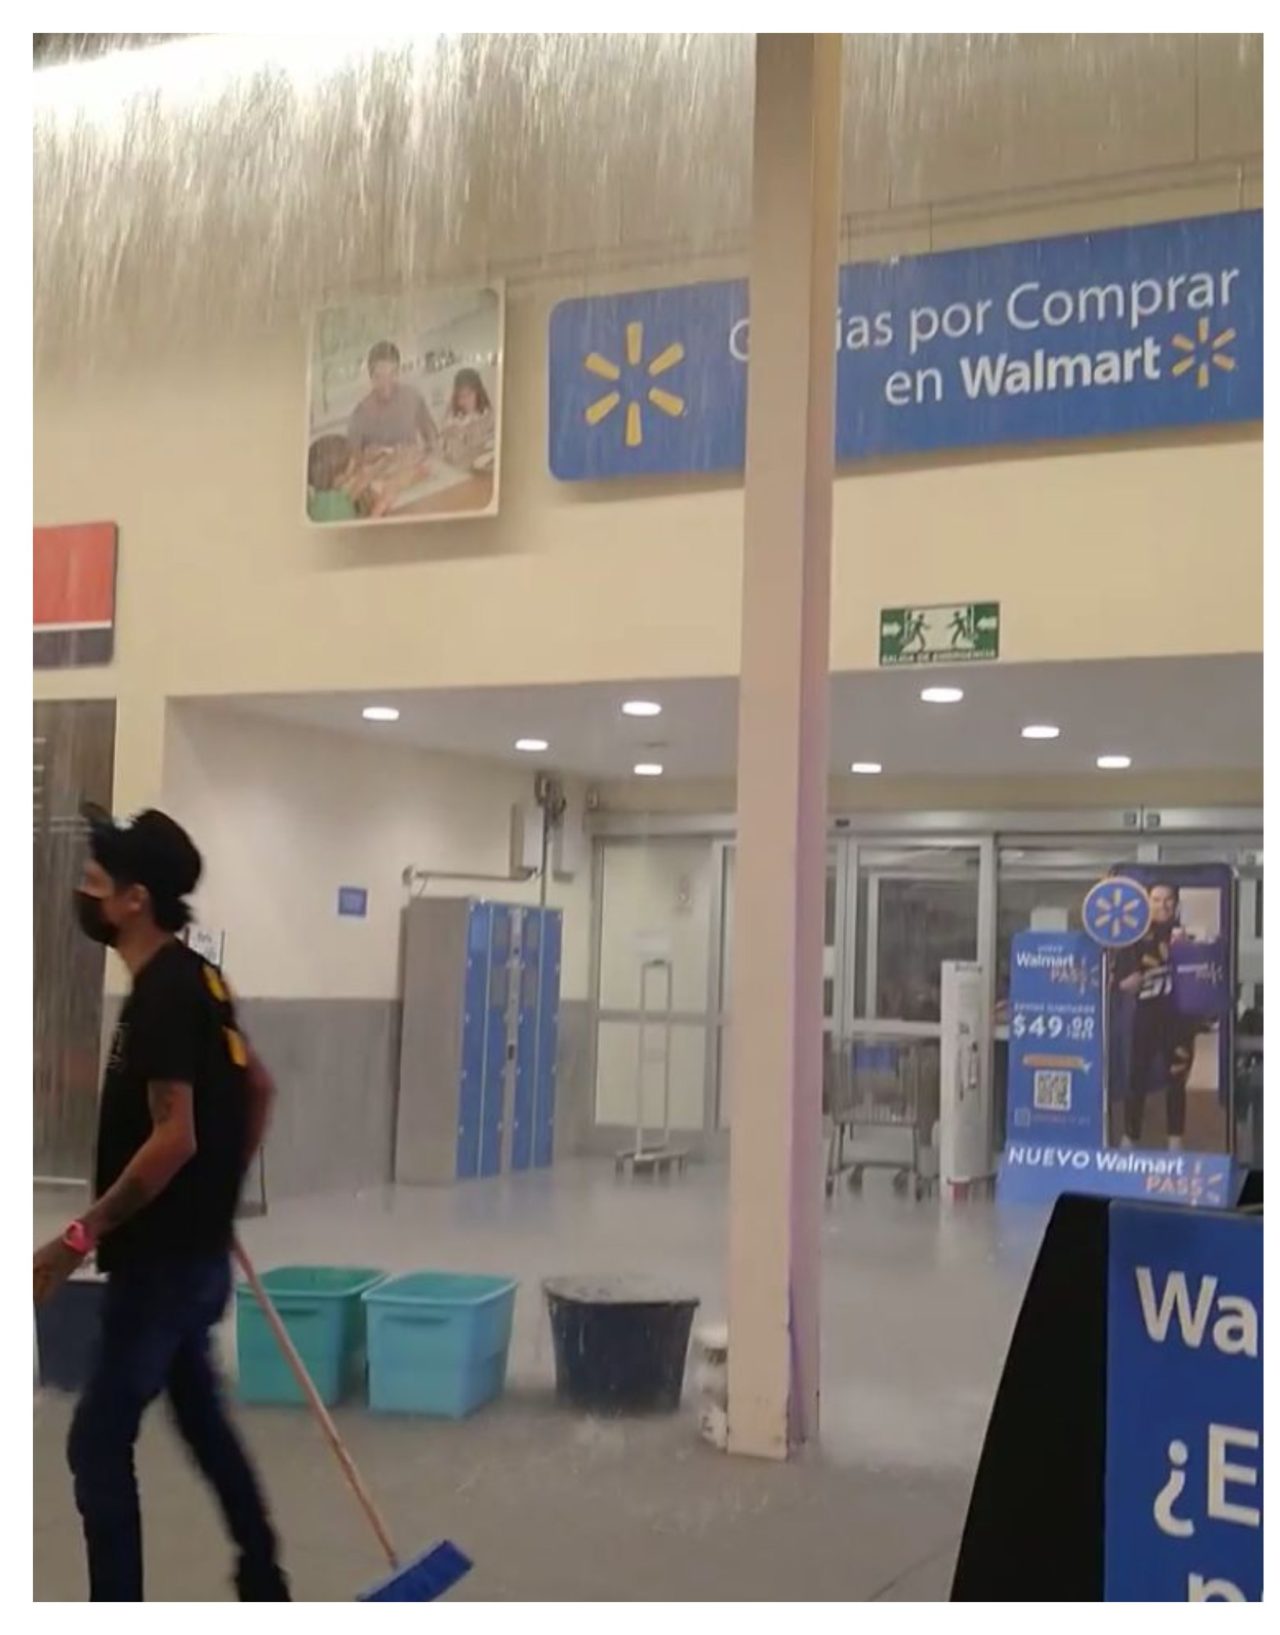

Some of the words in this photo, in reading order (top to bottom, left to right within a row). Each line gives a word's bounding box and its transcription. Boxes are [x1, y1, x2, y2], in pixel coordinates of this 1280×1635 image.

[909, 298, 992, 354] por
[1006, 266, 1240, 330] Comprar
[885, 366, 943, 406] en
[960, 337, 1161, 399] Walmart
[1016, 951, 1074, 969] Walmart
[1008, 1146, 1090, 1169] NUEVO
[1096, 1151, 1184, 1176] Walmart
[1135, 1266, 1259, 1358] Wa
